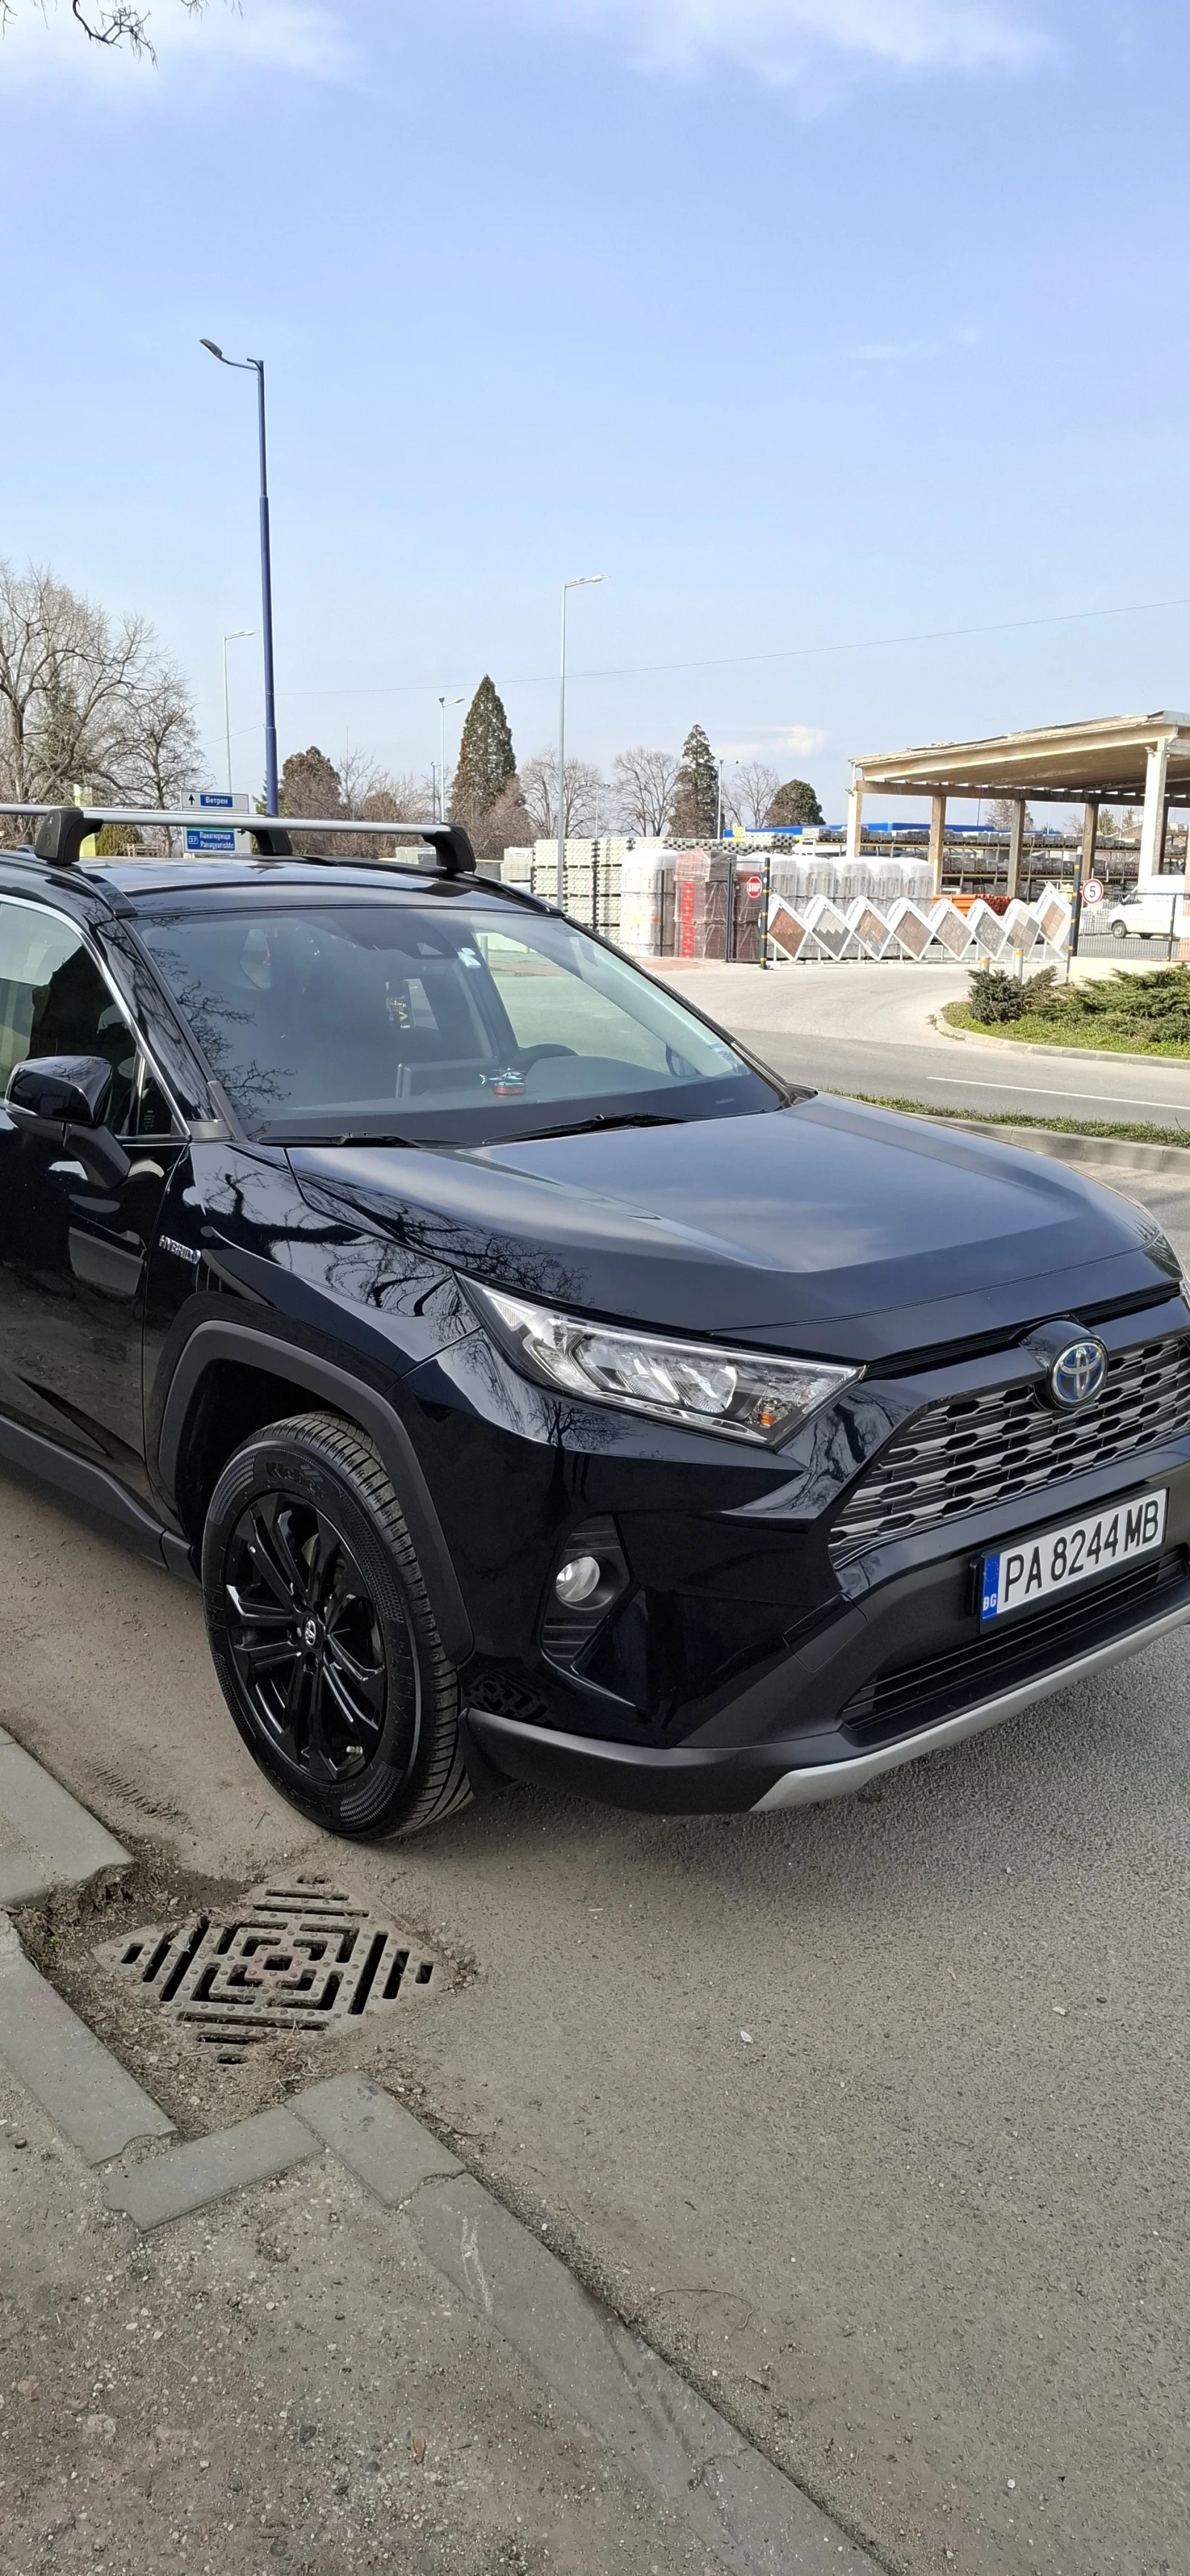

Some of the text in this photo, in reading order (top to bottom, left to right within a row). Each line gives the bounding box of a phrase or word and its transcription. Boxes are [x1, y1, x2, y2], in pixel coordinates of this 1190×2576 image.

[205, 796, 228, 805] Ветрен
[747, 882, 761, 892] STOP
[1089, 885, 1097, 898] 5
[158, 1234, 194, 1263] HYBRID
[1004, 1498, 1160, 1603] PA 8244 MB
[982, 1593, 997, 1611] BG
